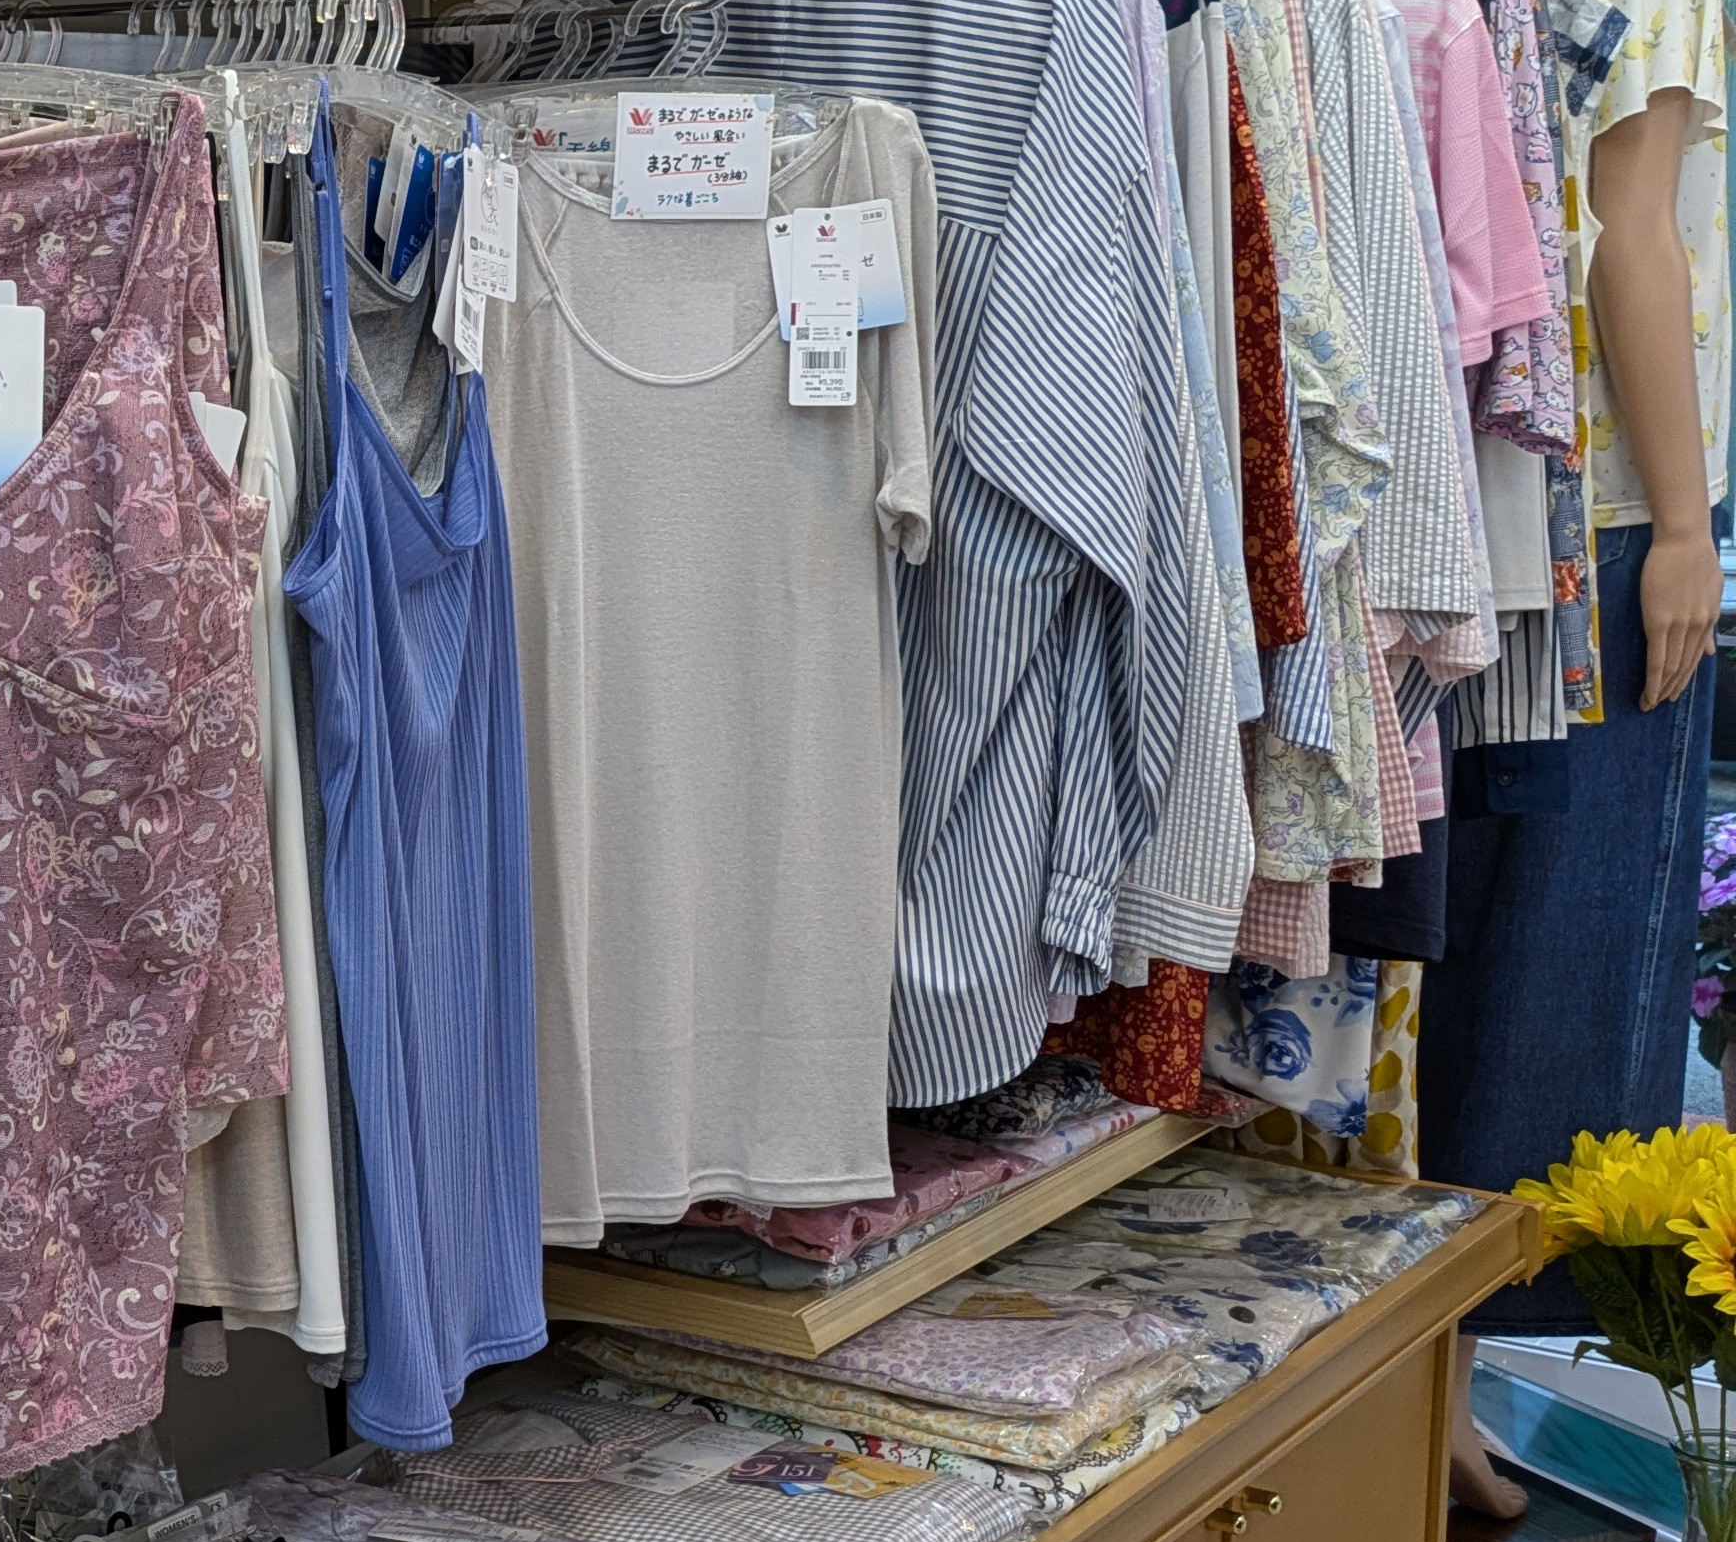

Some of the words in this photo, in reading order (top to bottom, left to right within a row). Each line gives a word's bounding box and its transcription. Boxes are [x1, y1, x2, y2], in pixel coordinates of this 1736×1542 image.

[647, 151, 731, 175] まるでガーゼ
[153, 1514, 198, 1540] WOMEN'S
